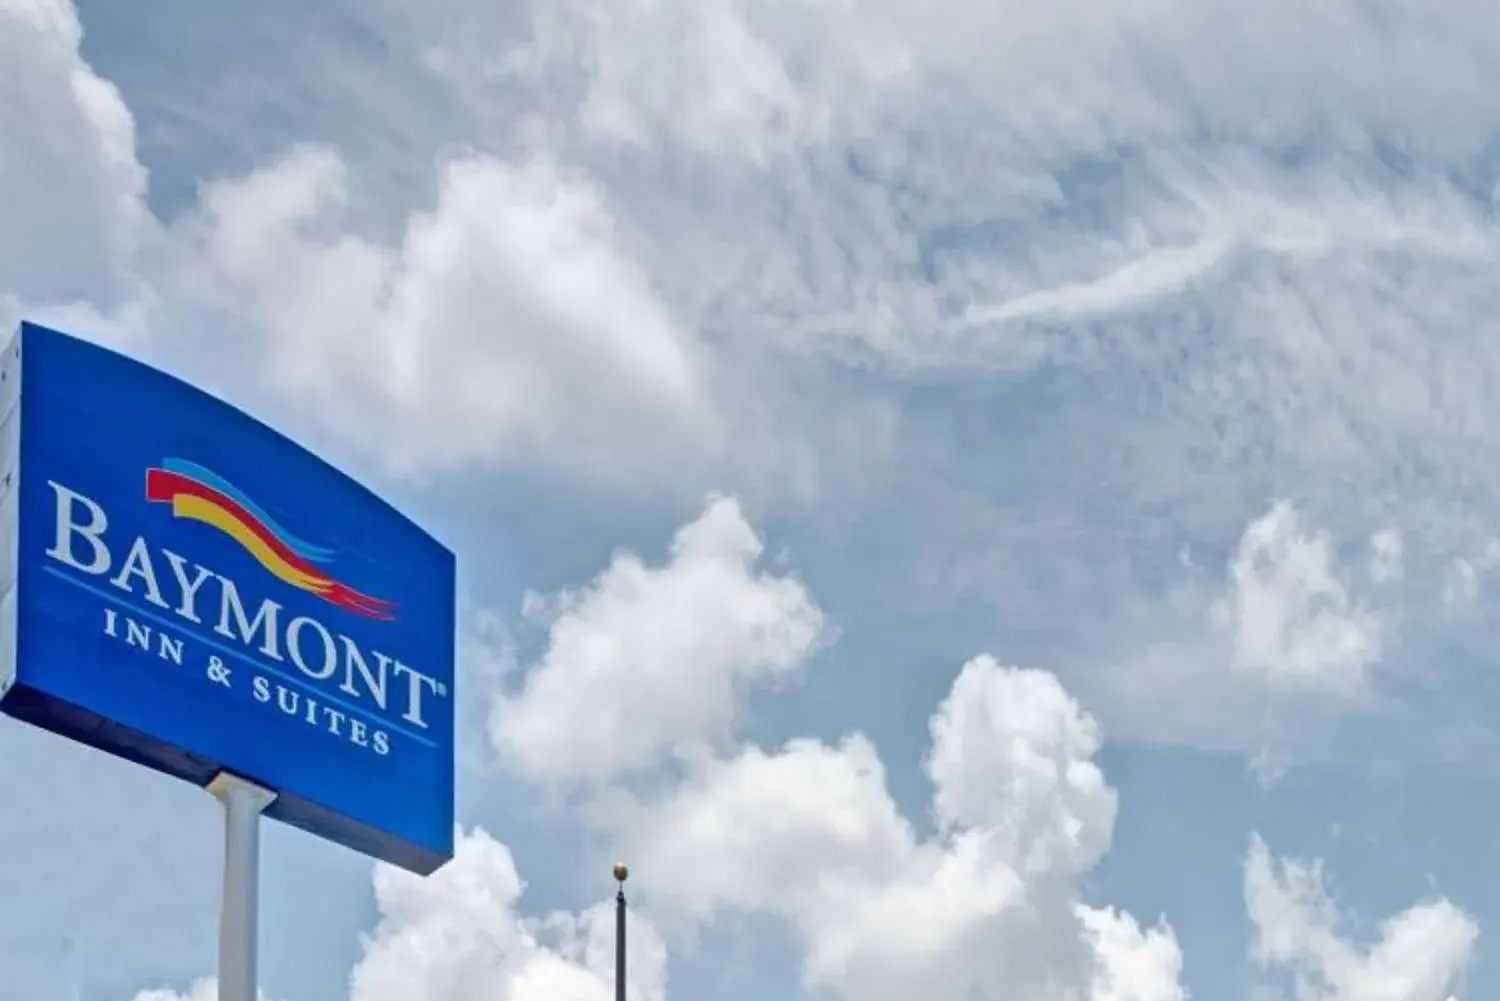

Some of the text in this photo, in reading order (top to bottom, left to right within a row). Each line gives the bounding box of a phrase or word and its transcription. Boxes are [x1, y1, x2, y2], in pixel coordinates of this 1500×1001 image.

[46, 480, 437, 729] BAYMONT
[103, 608, 391, 756] INN & SUITES
